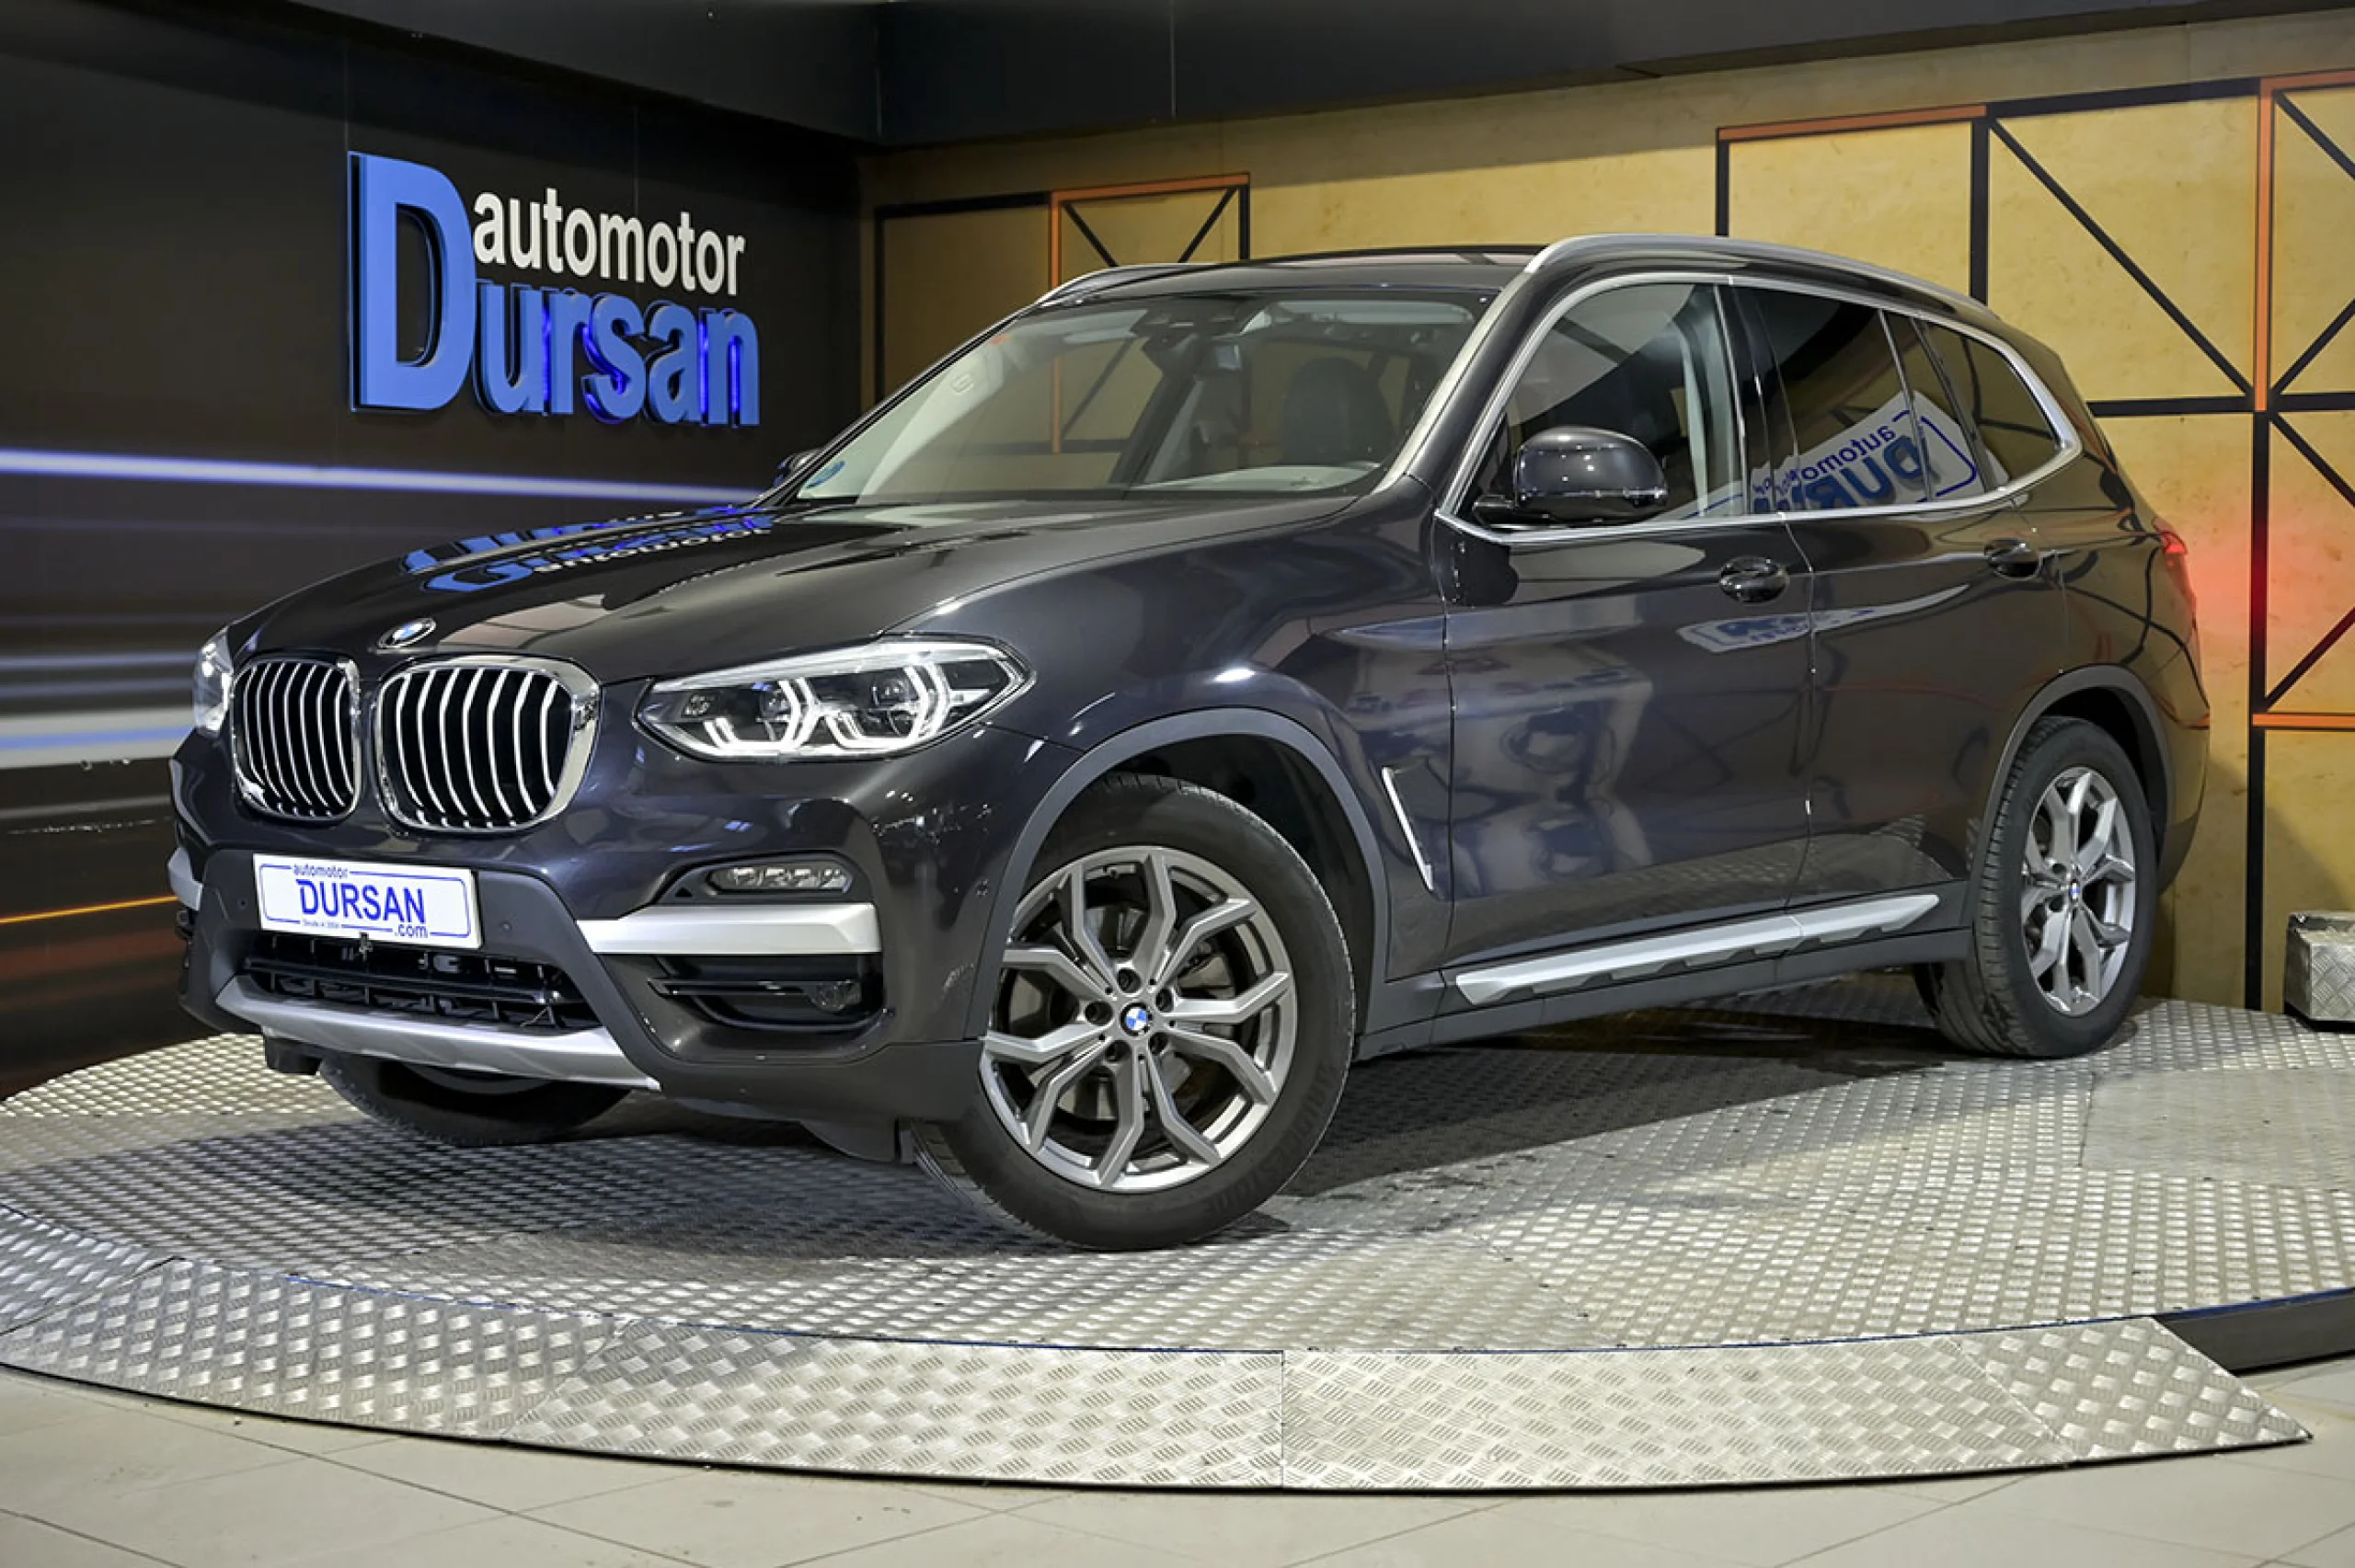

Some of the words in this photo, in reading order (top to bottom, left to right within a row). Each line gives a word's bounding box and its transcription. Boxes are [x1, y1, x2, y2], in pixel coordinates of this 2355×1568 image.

[473, 188, 746, 296] automotor
[349, 151, 761, 427] Dursan
[293, 864, 349, 878] automotor
[296, 879, 426, 923] DURSAN
[394, 923, 430, 939] .com
